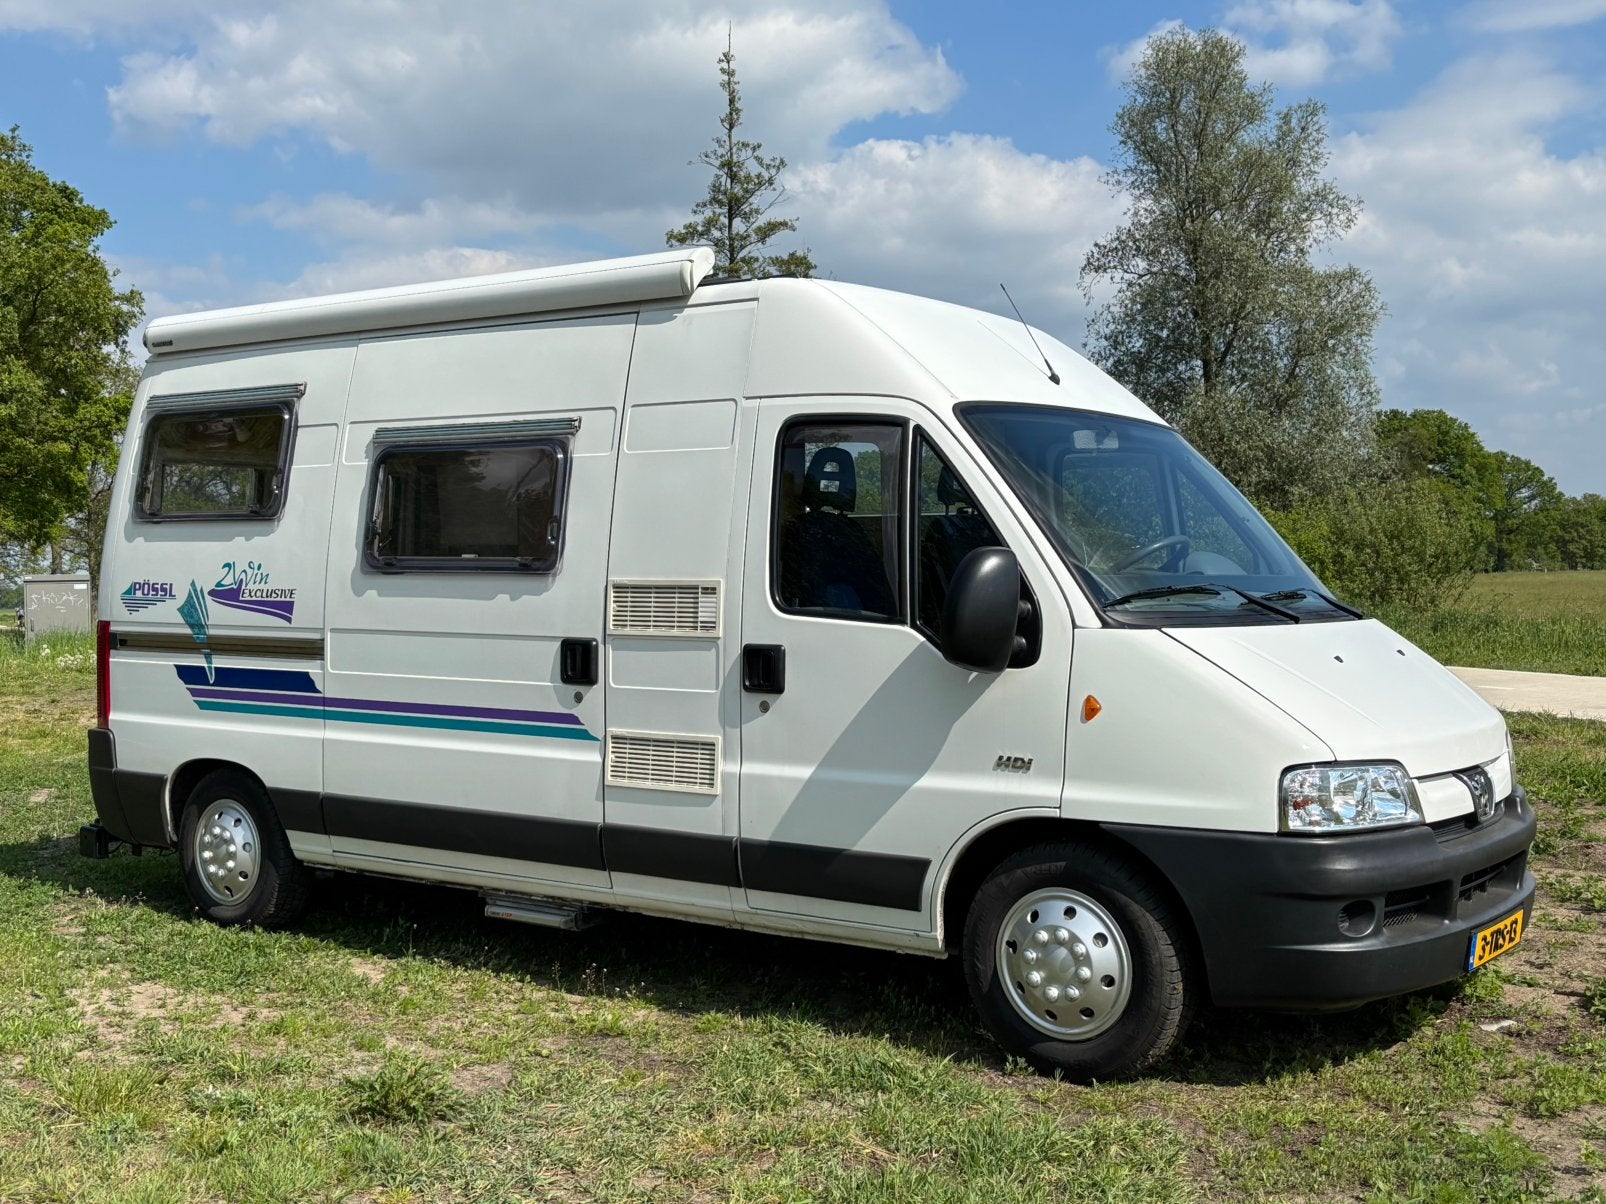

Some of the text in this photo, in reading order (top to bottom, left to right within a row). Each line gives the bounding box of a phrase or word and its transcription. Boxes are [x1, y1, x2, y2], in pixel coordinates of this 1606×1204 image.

[214, 561, 270, 588] 2Win
[133, 579, 176, 598] PÖSSL
[240, 588, 297, 600] EXCLUSIVE
